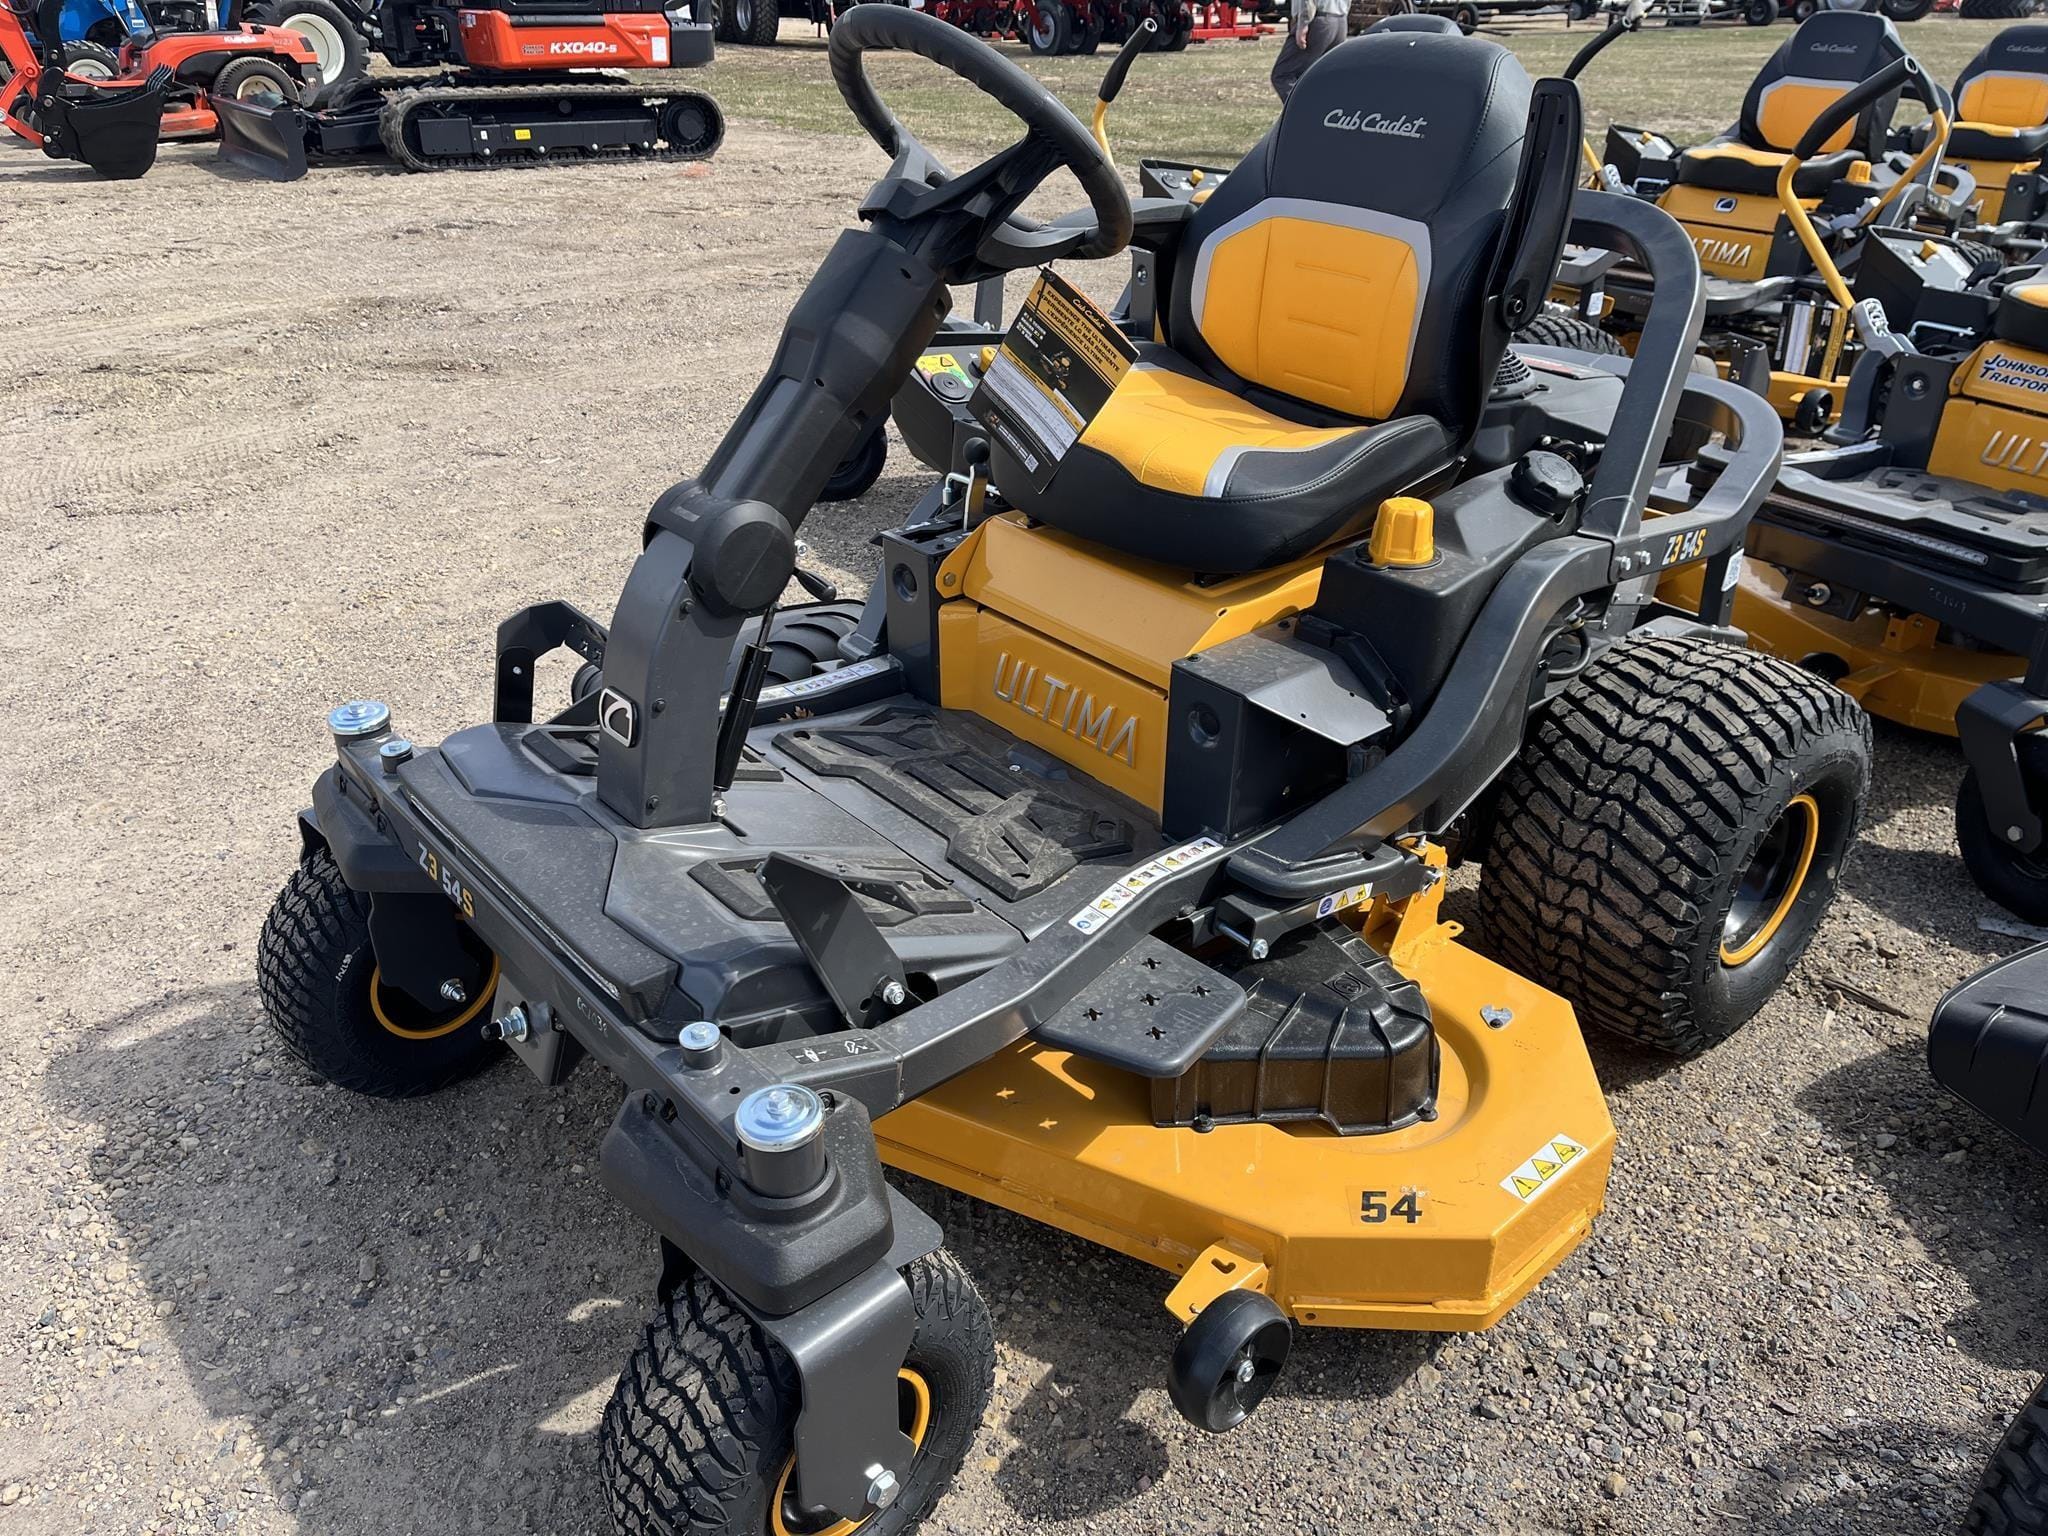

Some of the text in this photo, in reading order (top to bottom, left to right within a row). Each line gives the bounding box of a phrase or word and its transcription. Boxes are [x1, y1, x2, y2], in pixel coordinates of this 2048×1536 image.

[1324, 109, 1427, 138] Cub Cadet
[1692, 237, 1752, 267] TIMA
[1046, 290, 1081, 323] EXPERIENCE
[1079, 321, 1092, 334] THE
[1090, 331, 1118, 359] ULTIMATE
[1073, 324, 1082, 334] LO
[1093, 344, 1120, 372] RECIENTE
[1082, 343, 1103, 364] ULTIME
[1984, 354, 2048, 377] JOHNSO
[1662, 528, 1707, 565] Z3 54S
[994, 651, 1139, 768] ULTIMA
[418, 841, 473, 918] Z3 54S
[1360, 1191, 1423, 1223] 54
